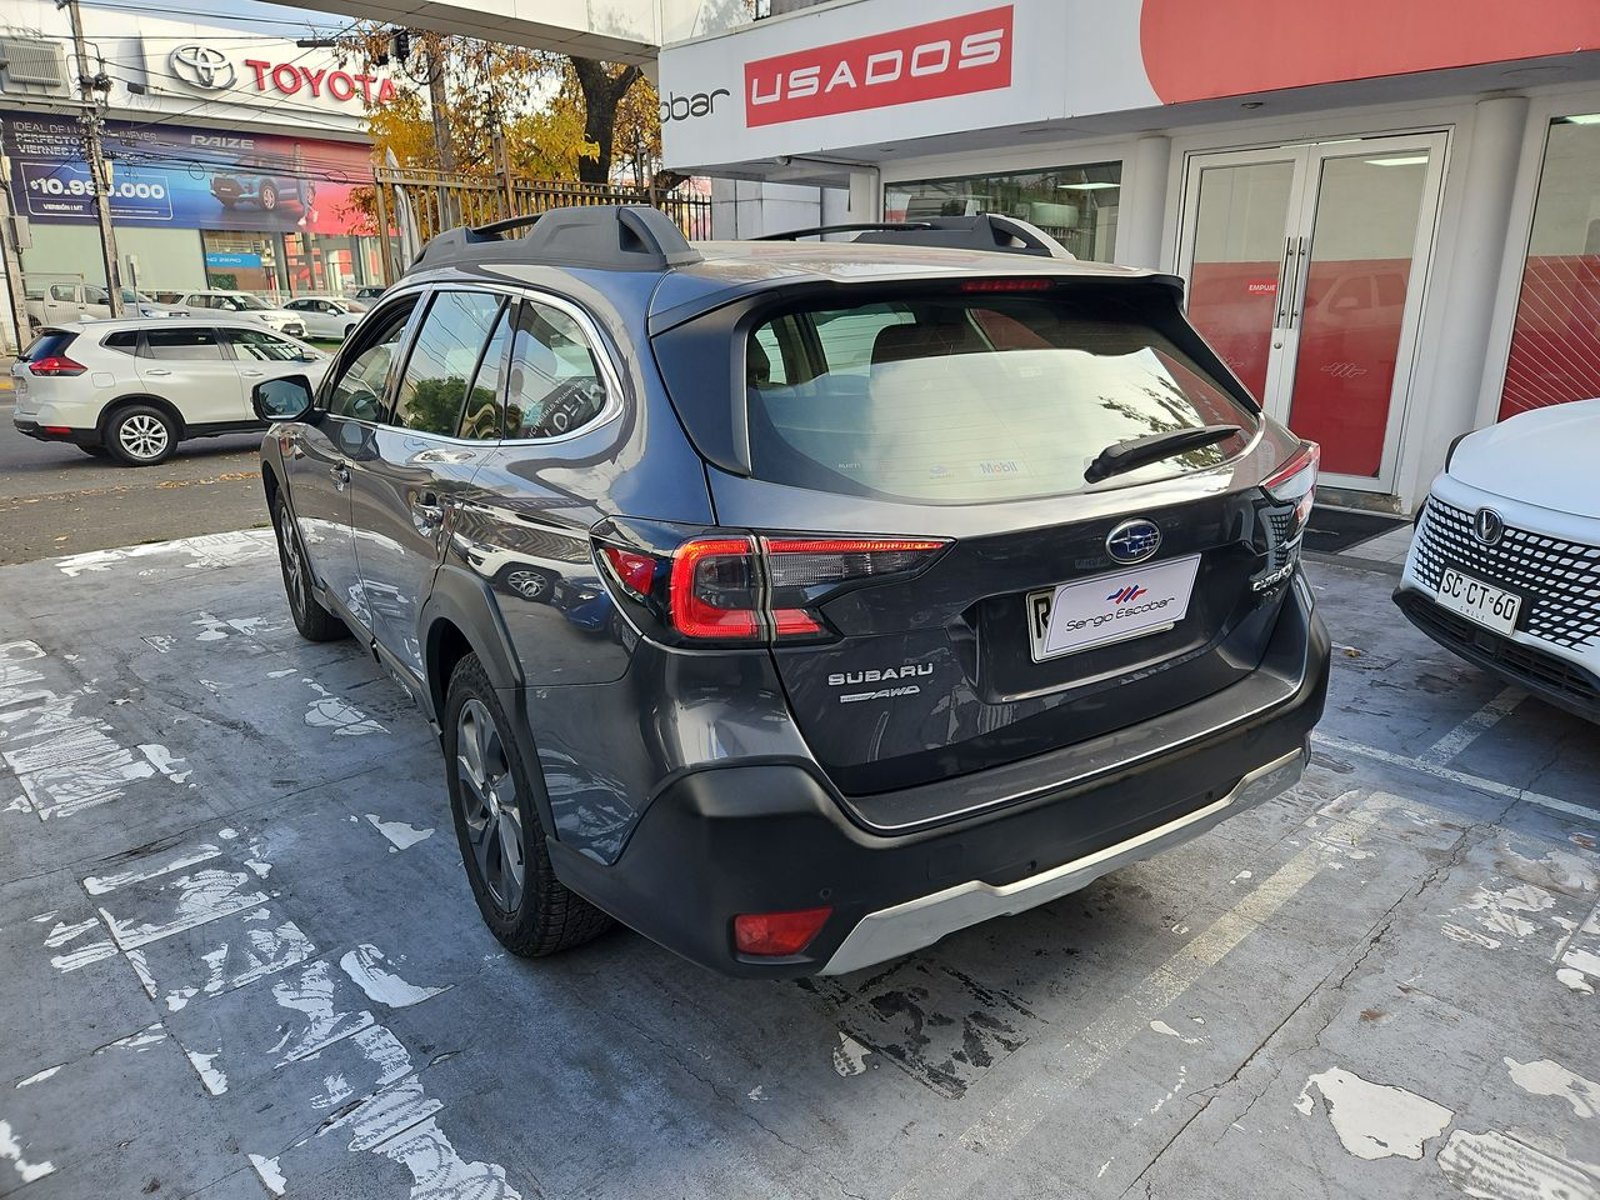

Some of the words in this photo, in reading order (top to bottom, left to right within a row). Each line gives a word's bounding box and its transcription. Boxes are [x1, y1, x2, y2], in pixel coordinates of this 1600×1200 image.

[752, 29, 1005, 105] USADOS
[245, 59, 398, 106] TOYOTA
[13, 121, 48, 133] IDEAL
[15, 133, 80, 145] PERFECTO
[191, 135, 254, 149] RAIZE
[980, 460, 1018, 474] Mobil
[1066, 613, 1114, 632] Sergio
[1115, 597, 1175, 619] Escobar
[828, 663, 933, 686] SUBARU
[871, 685, 920, 700] AWD
